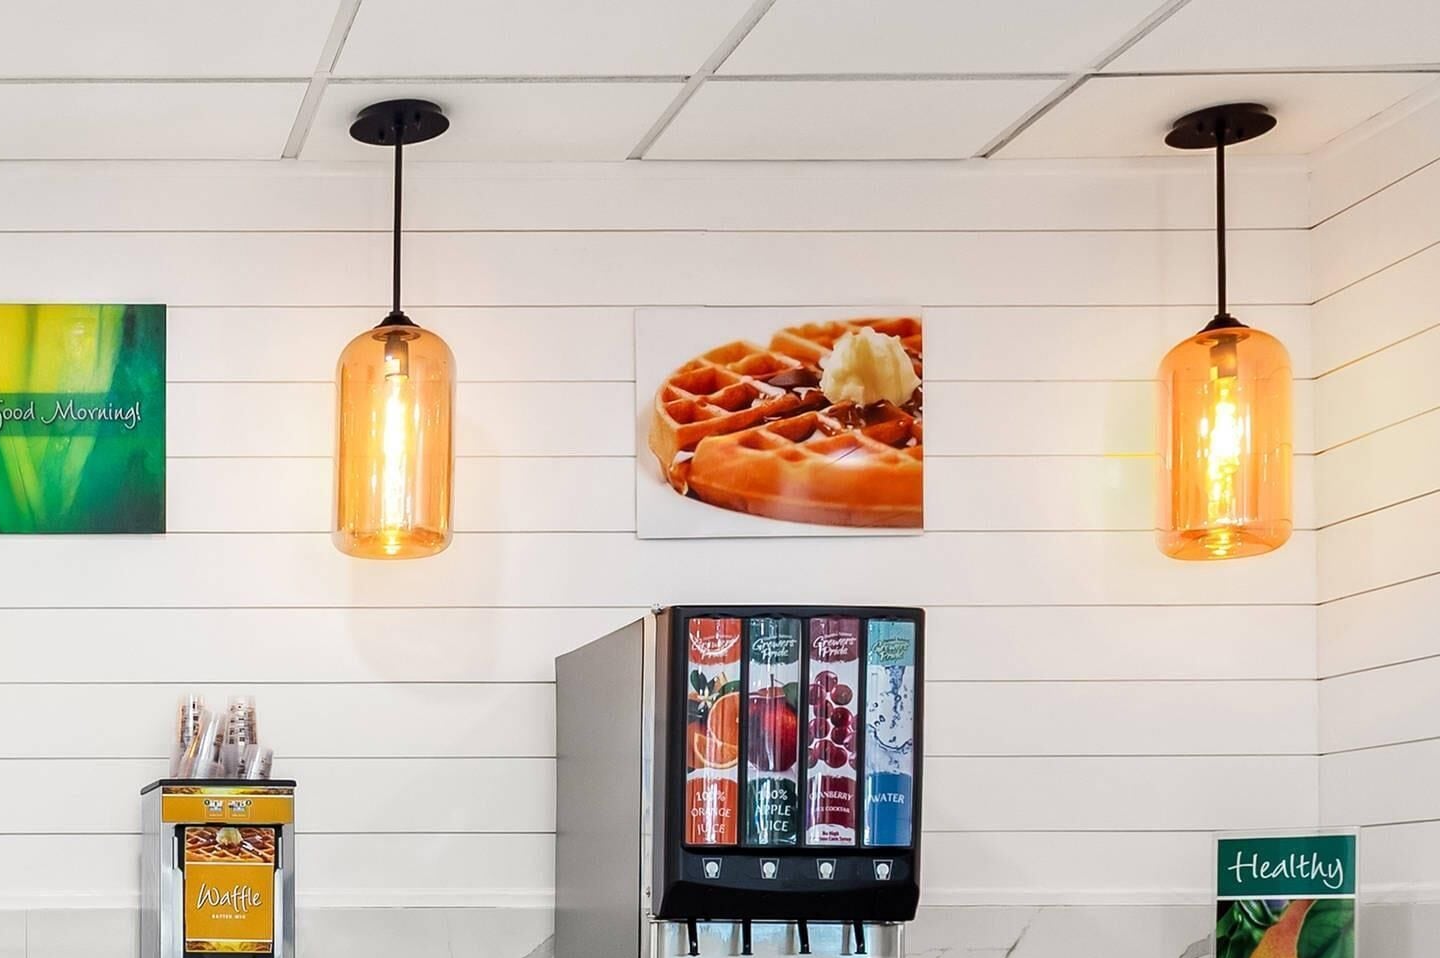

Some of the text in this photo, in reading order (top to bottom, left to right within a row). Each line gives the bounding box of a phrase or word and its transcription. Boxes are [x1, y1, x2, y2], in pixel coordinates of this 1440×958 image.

[40, 400, 142, 430] Morning!
[695, 790, 726, 802] 10%
[756, 788, 788, 801] 10%
[809, 790, 854, 801] CANBERRY
[868, 791, 905, 804] WATER
[697, 823, 725, 835] JUCE
[1227, 851, 1344, 889] Healthy
[197, 883, 262, 912] Waffle
